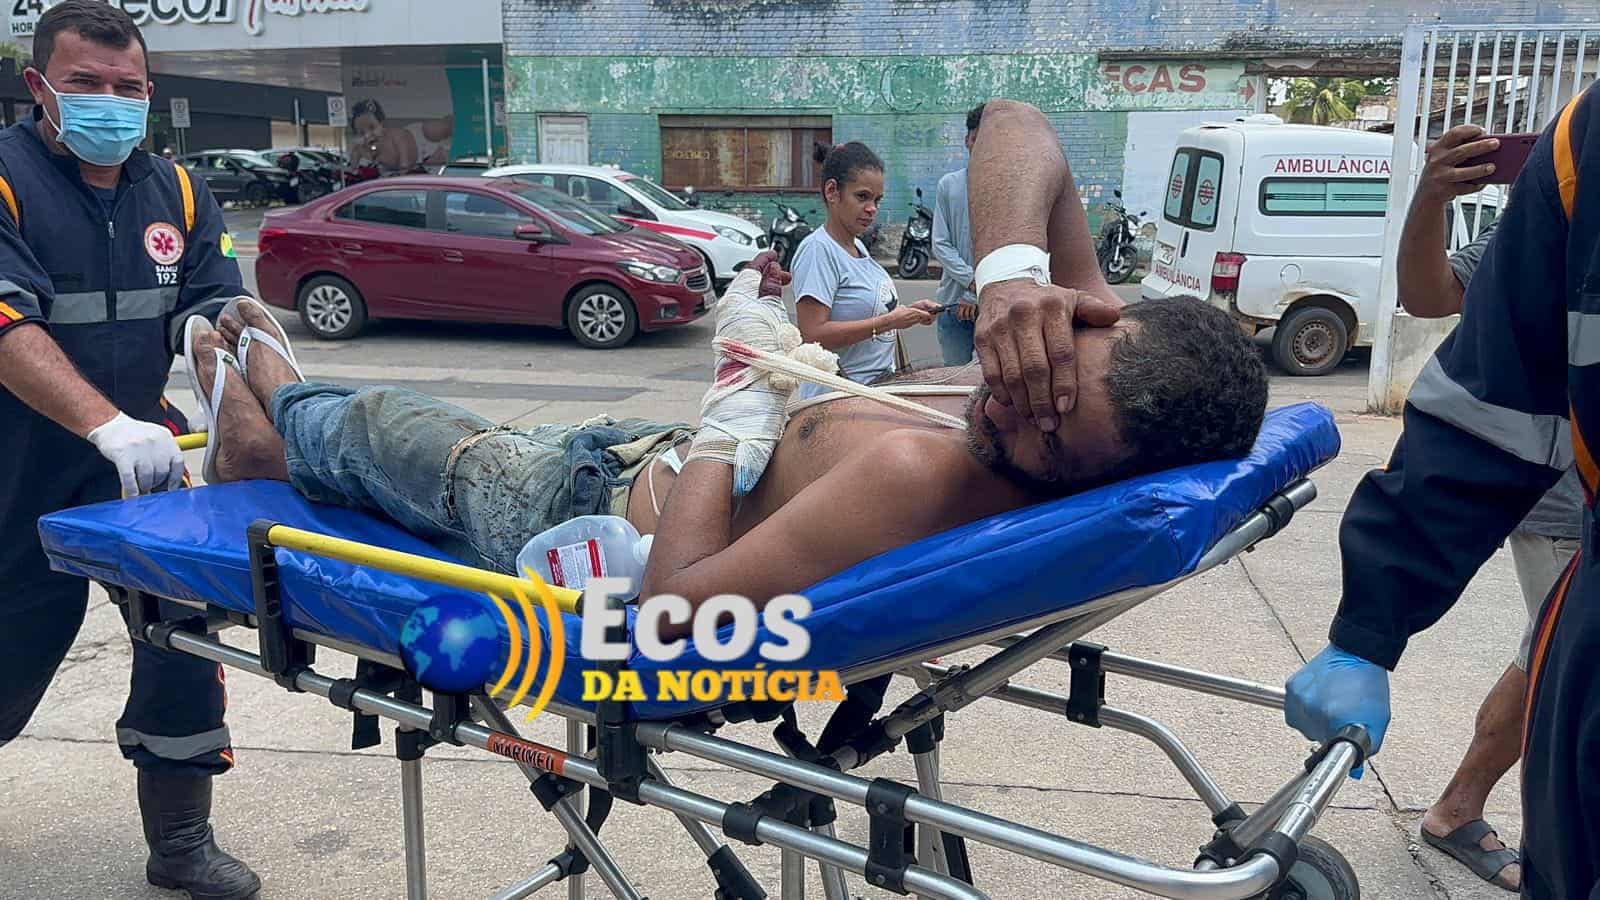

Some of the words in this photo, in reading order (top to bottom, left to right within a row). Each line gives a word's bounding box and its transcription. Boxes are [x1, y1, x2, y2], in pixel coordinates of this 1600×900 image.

[11, 22, 35, 33] HOR
[1274, 154, 1391, 174] AMBULÂNCIA
[156, 272, 177, 285] 192
